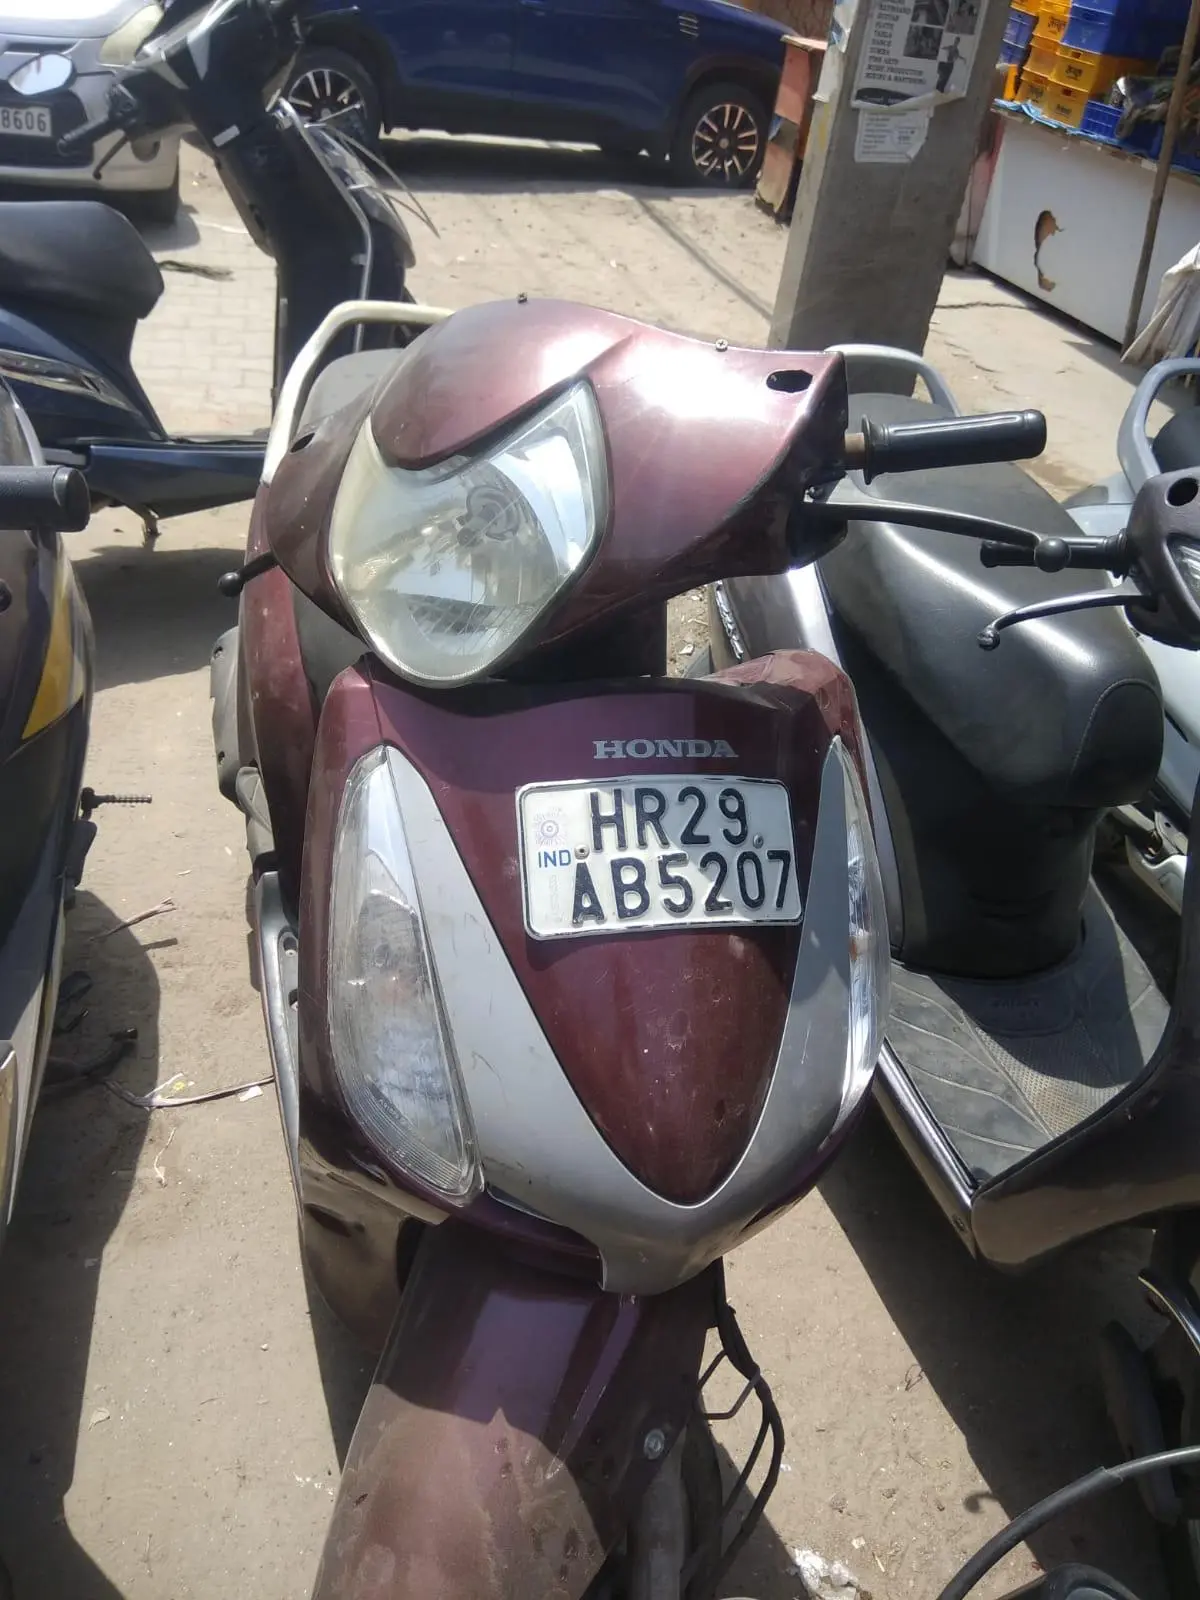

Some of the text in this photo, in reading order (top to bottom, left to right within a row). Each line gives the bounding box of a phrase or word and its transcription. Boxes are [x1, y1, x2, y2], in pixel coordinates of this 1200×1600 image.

[1, 109, 46, 132] 8606
[592, 739, 739, 759] HONDA
[589, 786, 749, 851] HR29
[537, 849, 572, 868] IND
[571, 849, 792, 928] AB5207
